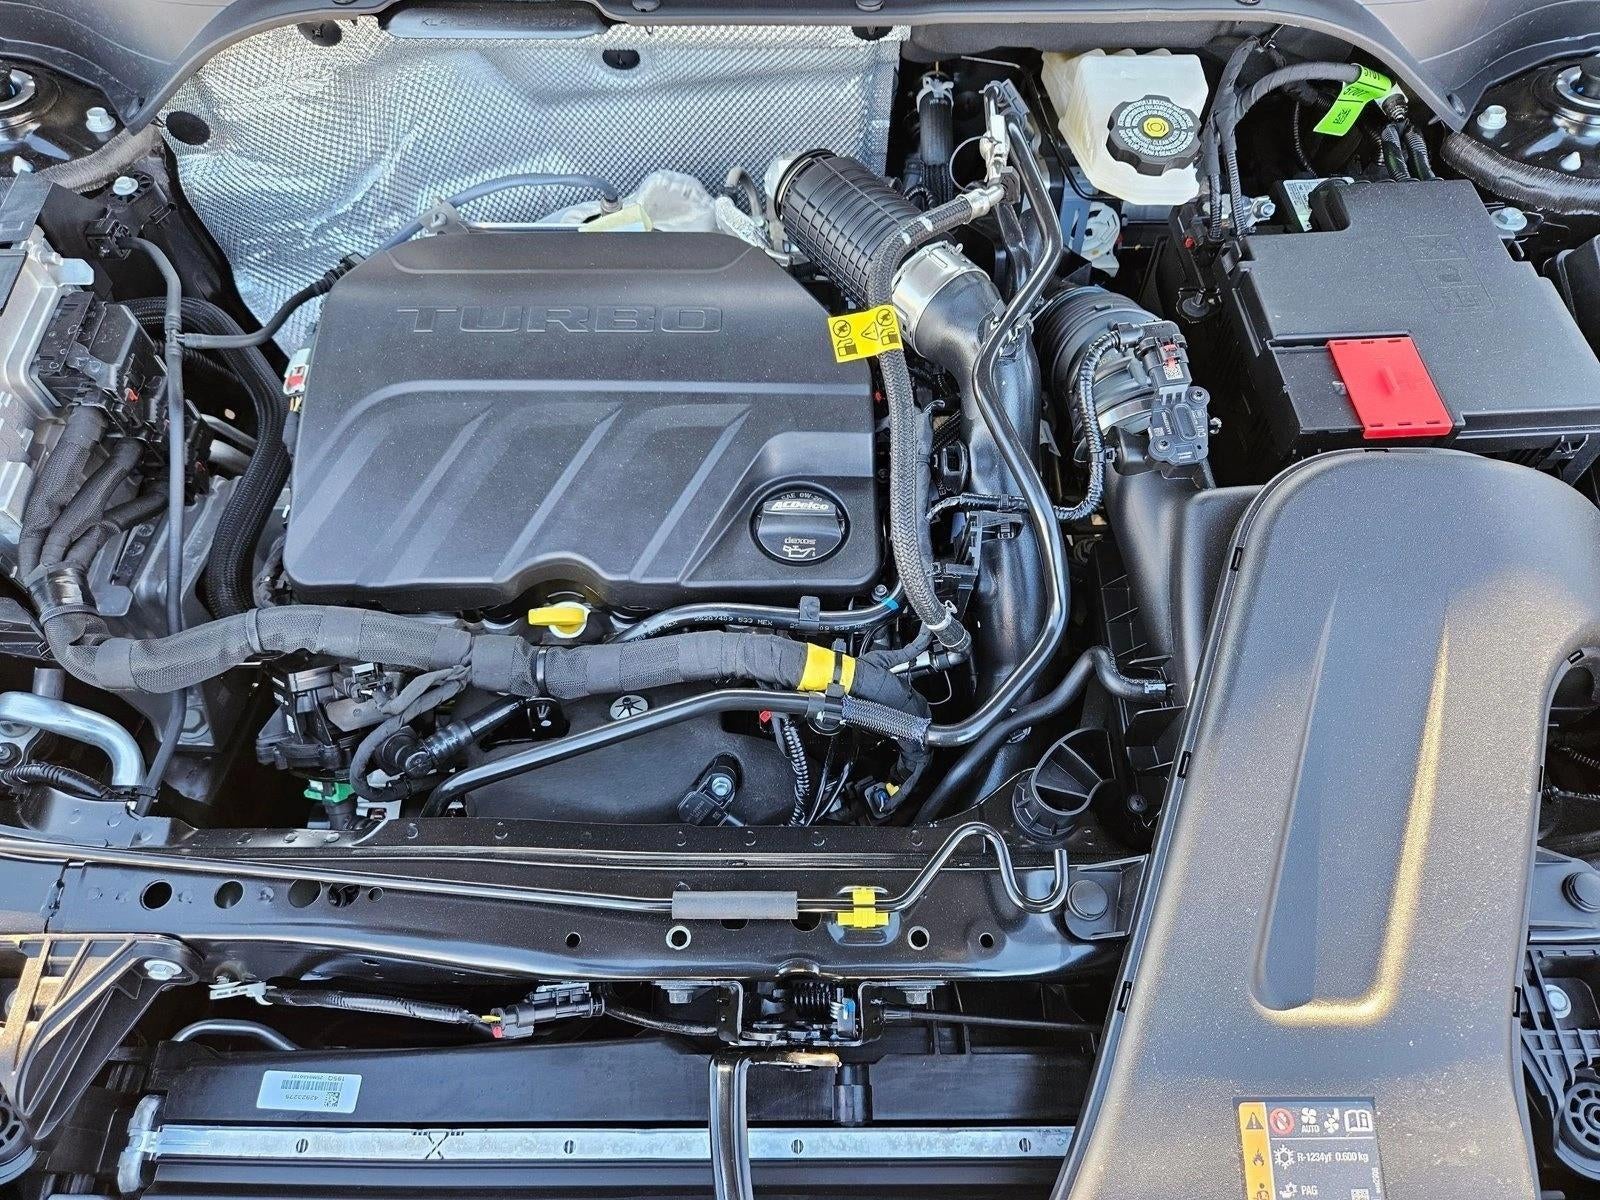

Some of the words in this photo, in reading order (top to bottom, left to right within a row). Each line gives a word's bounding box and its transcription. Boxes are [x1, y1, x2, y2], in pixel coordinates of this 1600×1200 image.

[396, 306, 724, 333] TURBO
[771, 501, 829, 510] ACDelco
[1302, 1125, 1320, 1133] AUTO
[1297, 1152, 1332, 1163] R-1234yf
[1335, 1152, 1357, 1162] 0.600
[1358, 1152, 1369, 1163] kg
[1301, 1185, 1318, 1195] PAG
